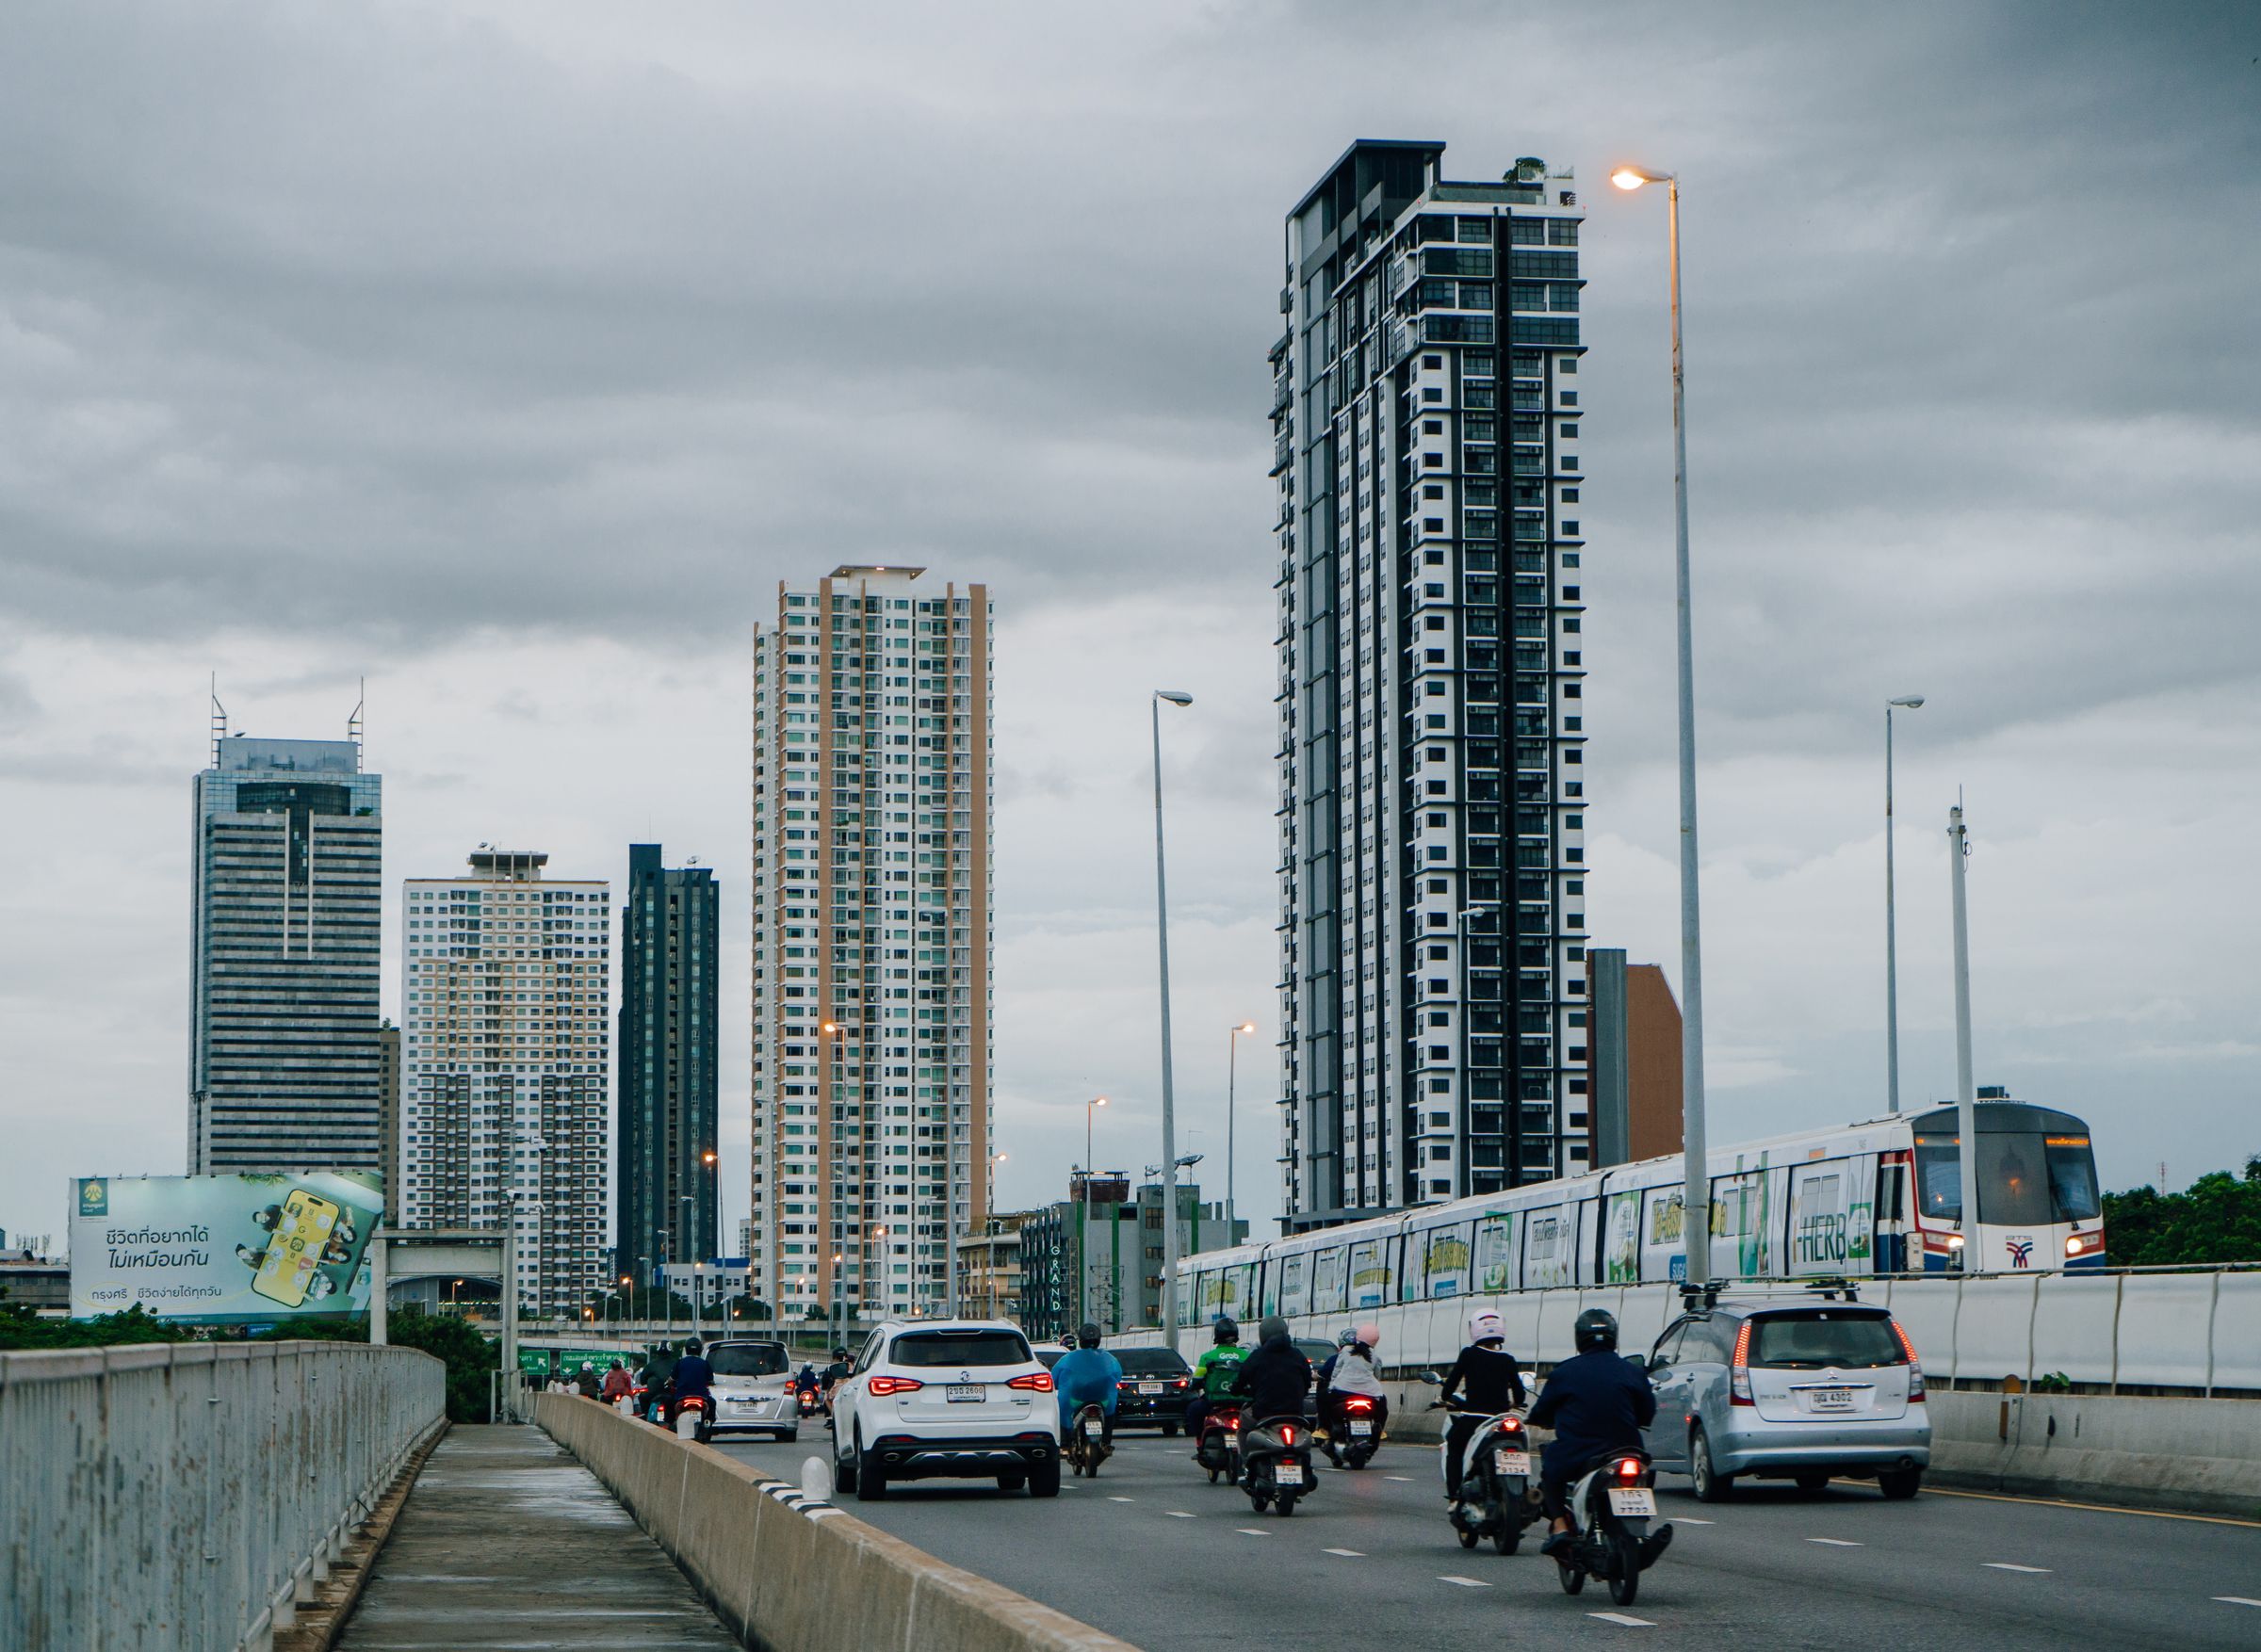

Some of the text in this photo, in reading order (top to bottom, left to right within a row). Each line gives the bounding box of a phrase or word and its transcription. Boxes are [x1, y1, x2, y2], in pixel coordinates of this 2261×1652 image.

[106, 1224, 209, 1244] ชีวิตที่อยากได้
[108, 1248, 209, 1268] ไม่เหมือนกัน
[1050, 1245, 1061, 1311] GRAND
[91, 1285, 222, 1302] กรุงศรี ชีวิตง่ายได้ทุกวัน
[1219, 1352, 1240, 1360] Grab
